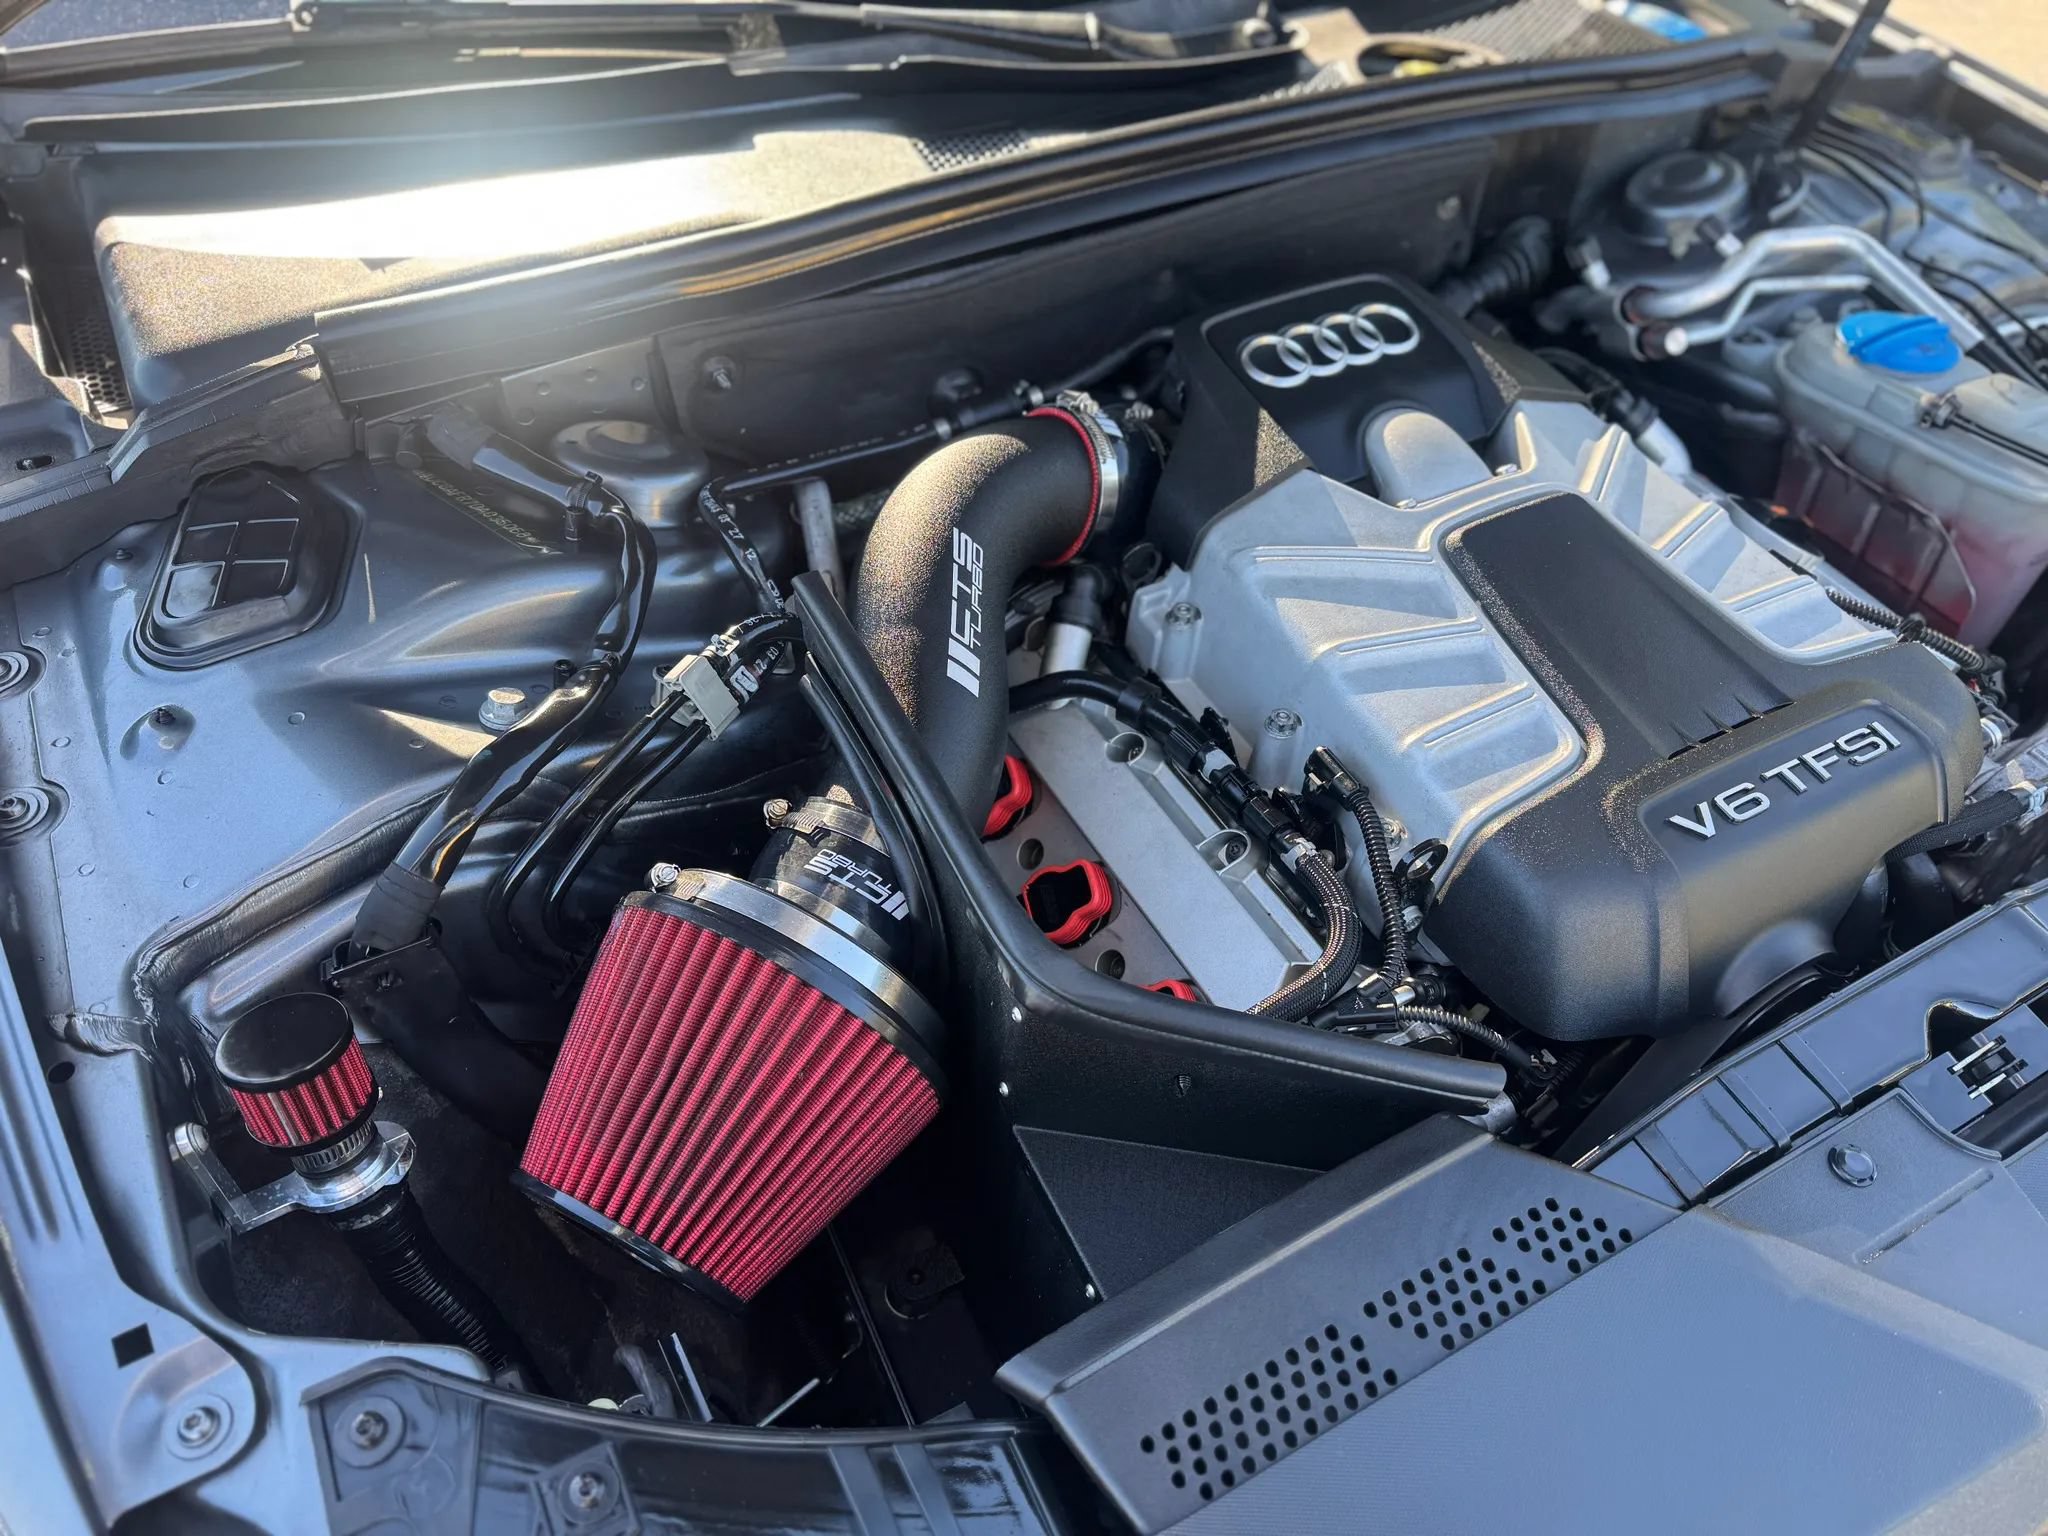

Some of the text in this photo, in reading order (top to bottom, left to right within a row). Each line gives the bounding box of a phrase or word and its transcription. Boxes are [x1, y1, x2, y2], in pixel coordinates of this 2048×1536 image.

[728, 526, 745, 540] 27
[744, 547, 757, 561] 12
[950, 526, 973, 646] CTS
[970, 542, 984, 650] TURBO
[1664, 721, 1901, 840] V6 TFSI
[803, 856, 893, 905] CTS
[817, 848, 893, 893] TURBO
